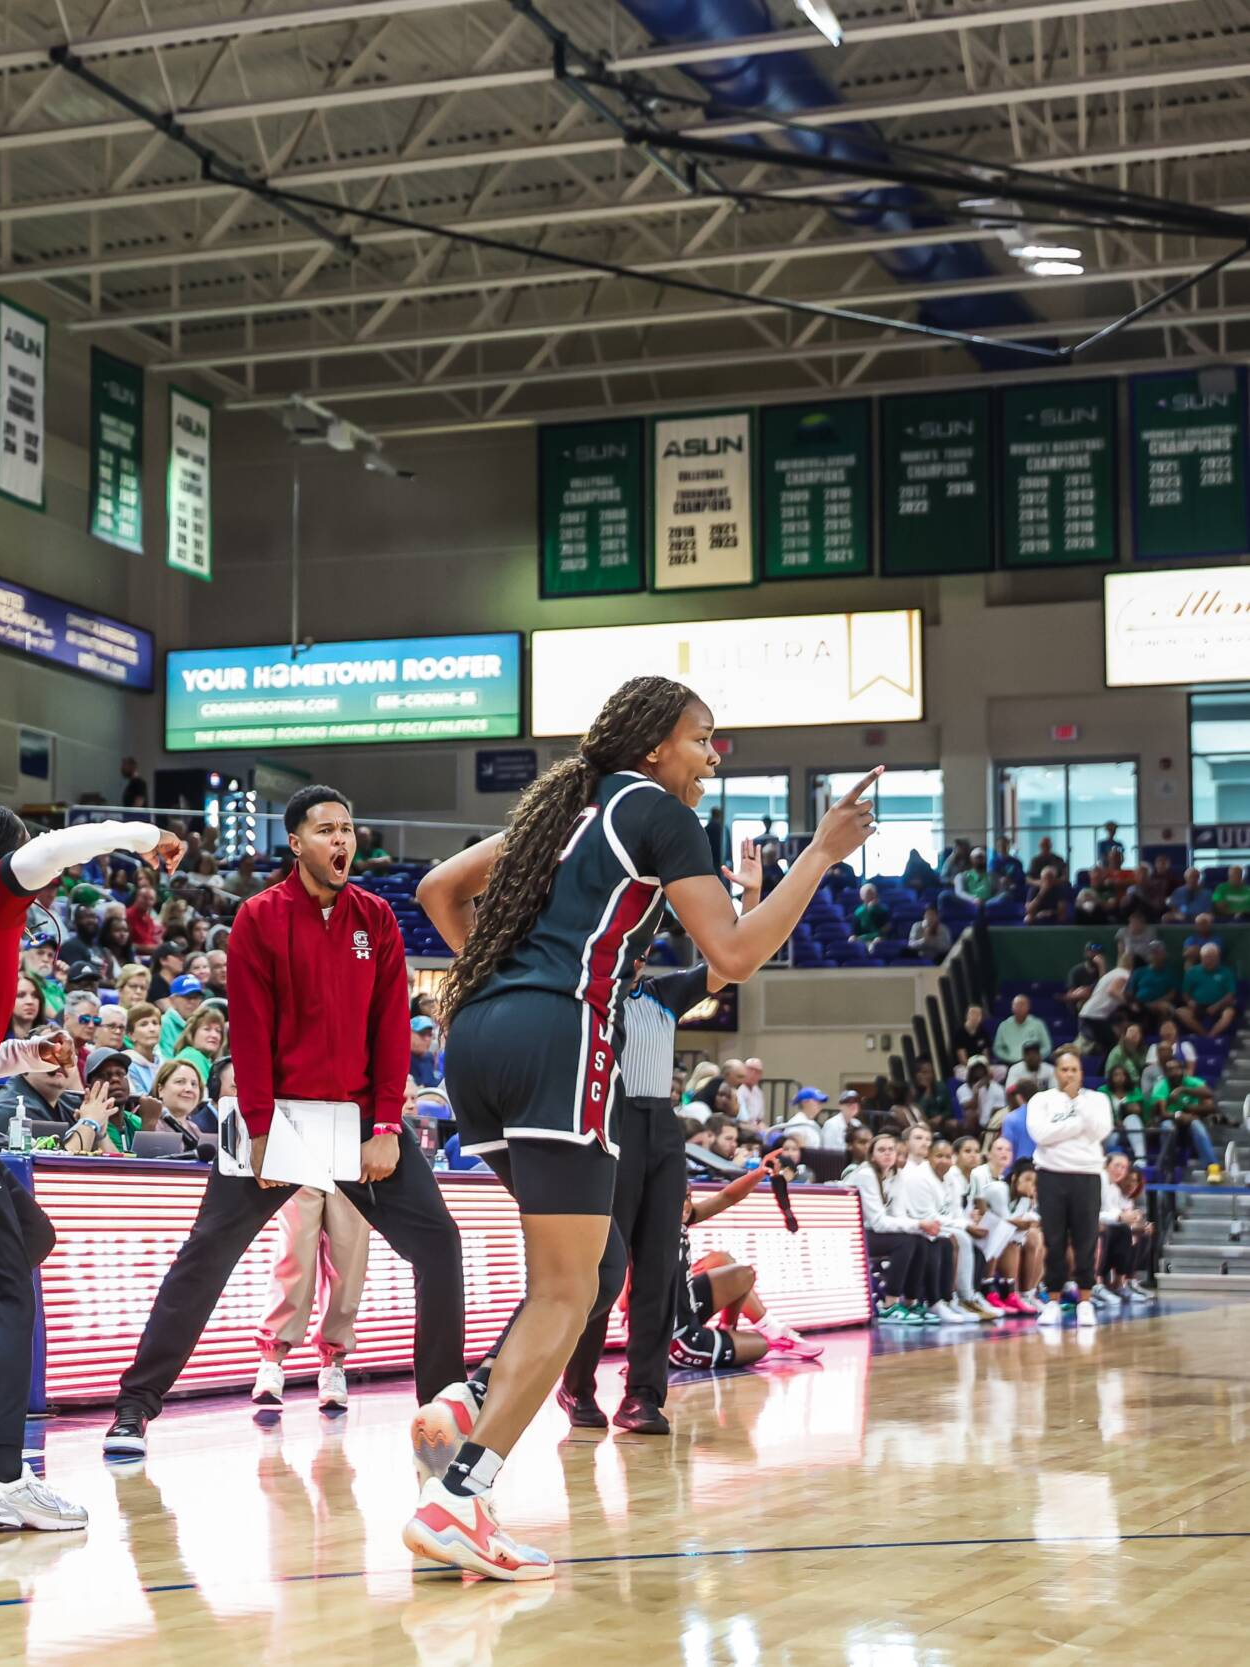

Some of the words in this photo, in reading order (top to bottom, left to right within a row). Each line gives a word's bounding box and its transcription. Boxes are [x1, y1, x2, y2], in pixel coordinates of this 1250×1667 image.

[662, 434, 744, 459] ASUN
[1148, 436, 1232, 457] CHAMPIONS
[906, 460, 969, 480] CHAMPIONS
[1025, 452, 1091, 472] CHAMPIONS
[785, 469, 846, 486] CHAMPIONS
[562, 487, 621, 506] CHAMPIONS
[673, 497, 732, 515] CHAMPIONS
[182, 667, 247, 692] YOUR
[253, 660, 397, 690] HOMETOWN
[402, 655, 501, 682] ROOFER
